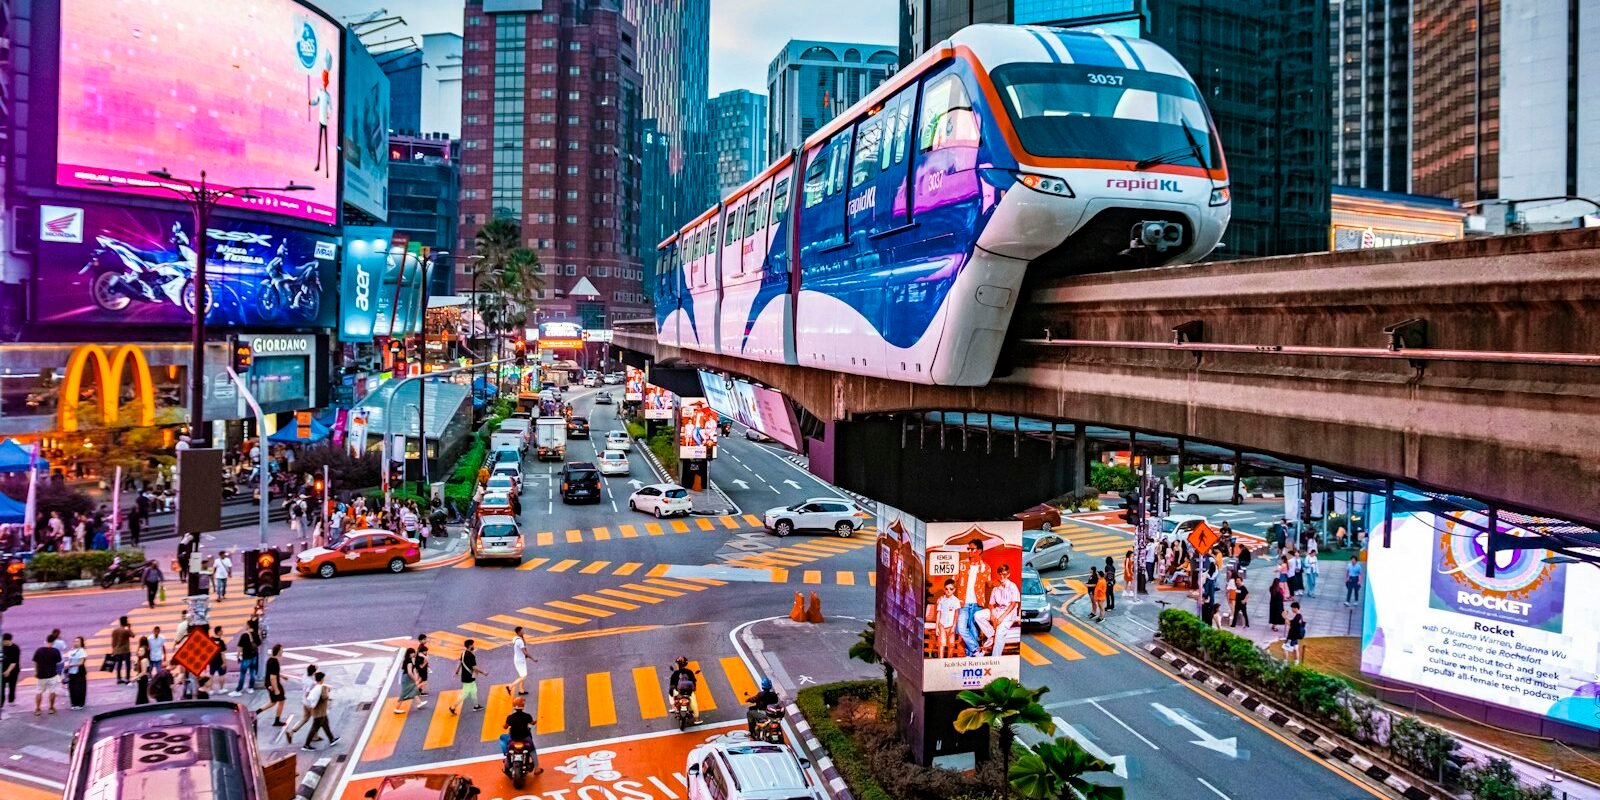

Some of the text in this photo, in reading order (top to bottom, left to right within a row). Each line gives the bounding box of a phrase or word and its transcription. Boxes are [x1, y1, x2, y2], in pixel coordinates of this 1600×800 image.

[1087, 73, 1124, 86] 3037
[928, 169, 944, 192] 3037
[1106, 177, 1184, 193] rapidKL
[847, 186, 877, 218] rapidKL
[45, 231, 77, 239] HONDA
[355, 263, 370, 312] acer
[253, 338, 307, 353] GIORDANO
[934, 564, 955, 574] RM59
[1457, 590, 1533, 616] ROCKET
[1422, 623, 1567, 660] with Christina Warren, Brianna Wu
[1474, 621, 1515, 638] Rocket
[1428, 645, 1560, 681] Geek out about tech and geek
[1443, 637, 1542, 665] & Simone de Rochefort
[962, 667, 992, 677] max
[1422, 665, 1456, 679] popular
[1457, 670, 1500, 688] all-female
[1501, 682, 1521, 693] tech
[1428, 656, 1558, 691] culture with the first and most
